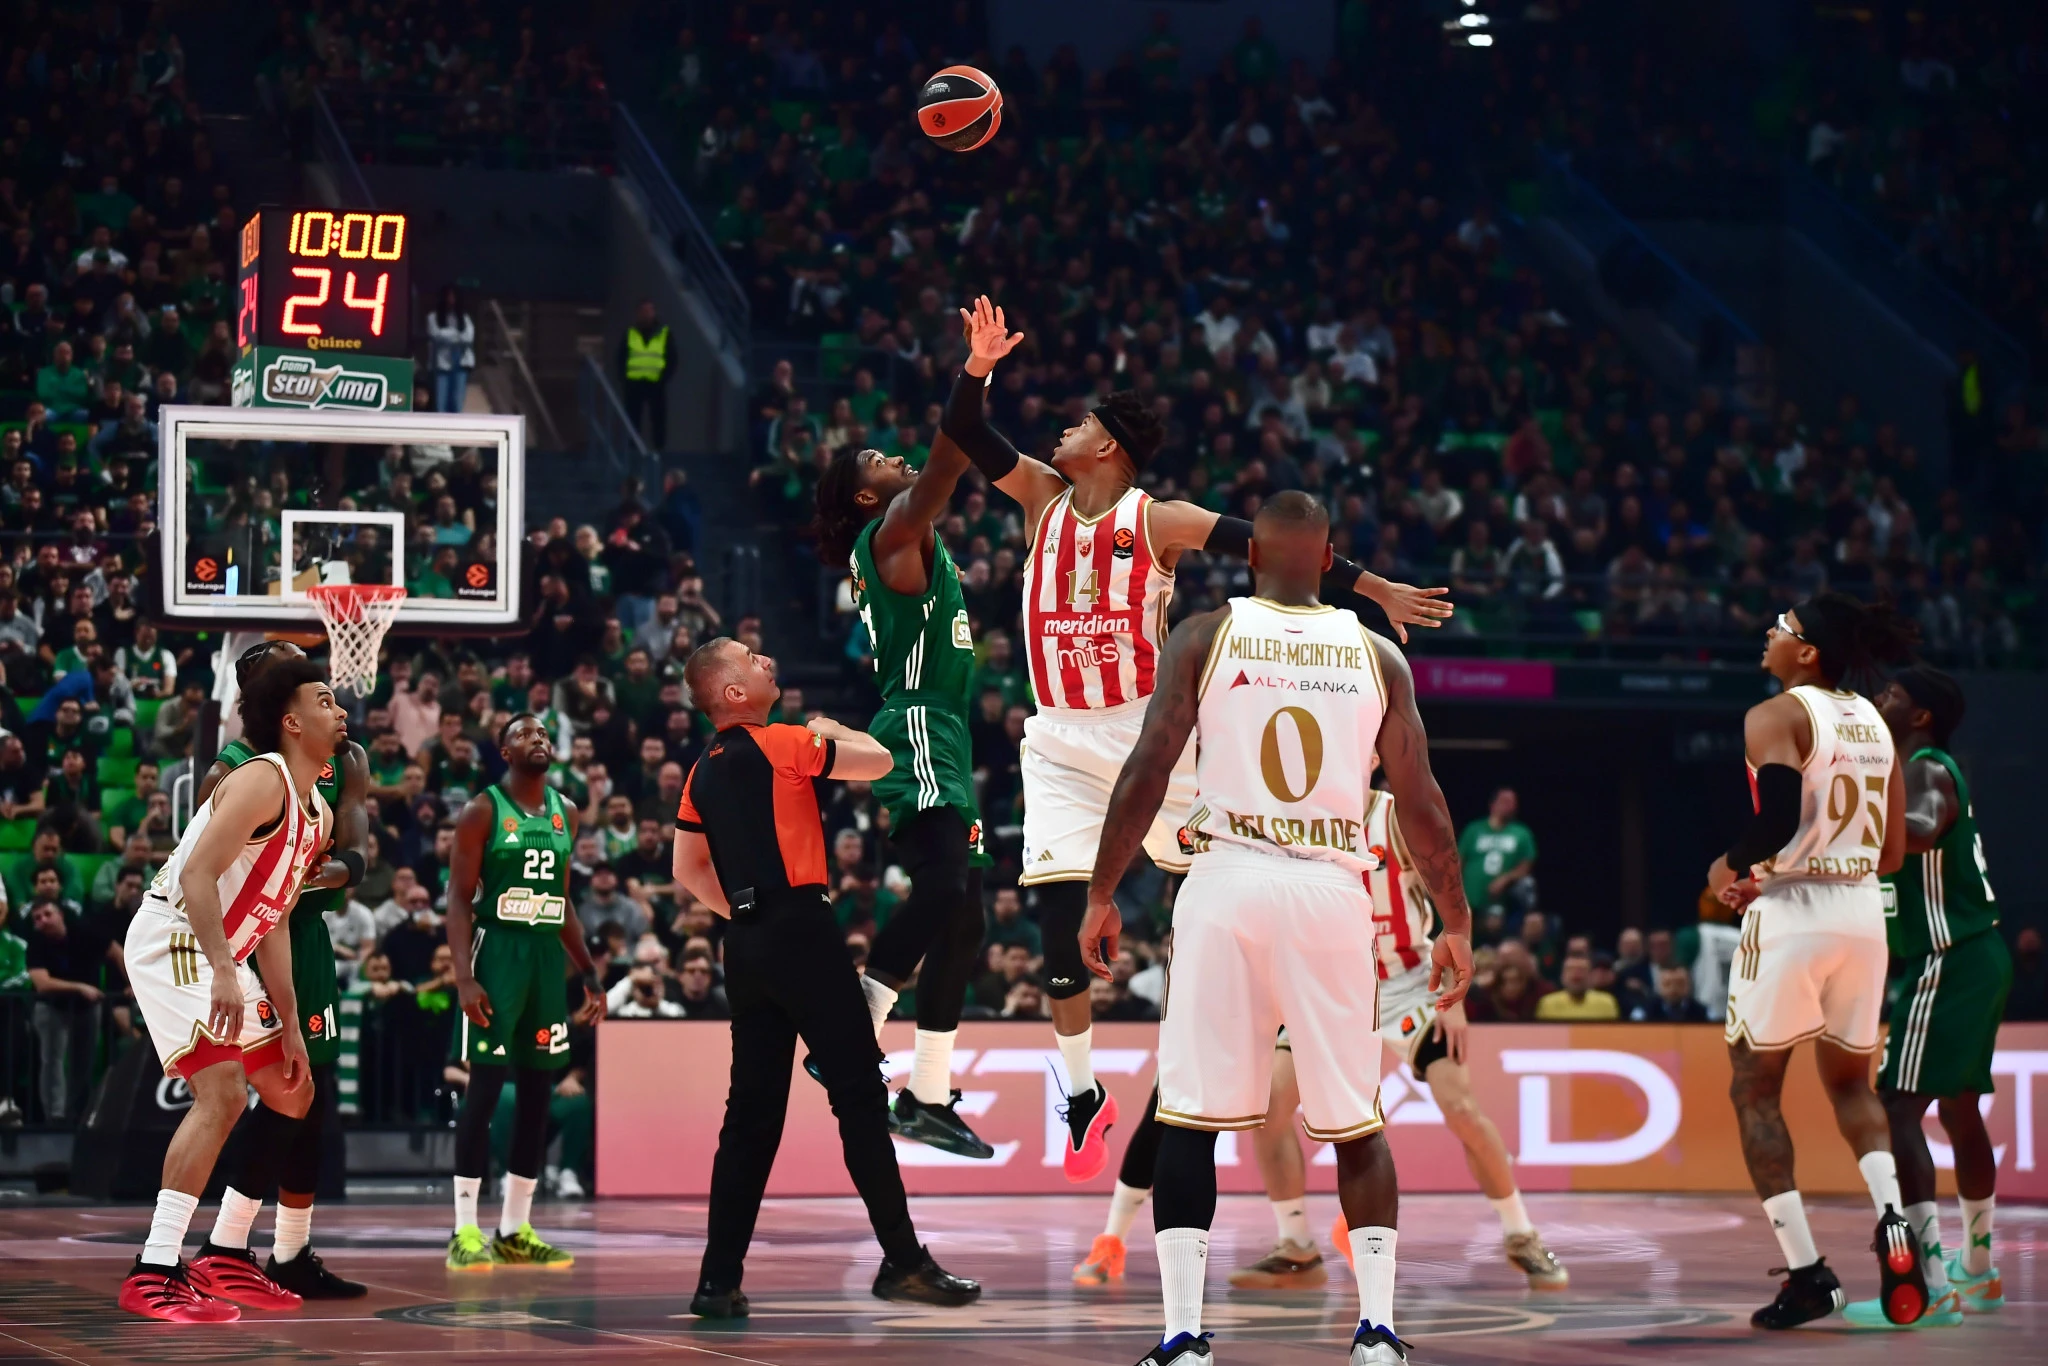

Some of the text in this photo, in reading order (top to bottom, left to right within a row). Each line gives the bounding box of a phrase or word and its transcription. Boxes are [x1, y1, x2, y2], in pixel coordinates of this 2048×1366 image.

[289, 211, 406, 261] 10:00
[281, 267, 389, 336] 24
[307, 336, 362, 349] Quince
[1065, 569, 1100, 605] 14
[1044, 614, 1130, 636] meridian
[1057, 640, 1120, 671] mts
[1228, 635, 1362, 670] MILLER-MCINTYRE
[1260, 705, 1324, 804] 0
[1826, 773, 1886, 850] 95
[523, 848, 555, 881] 22
